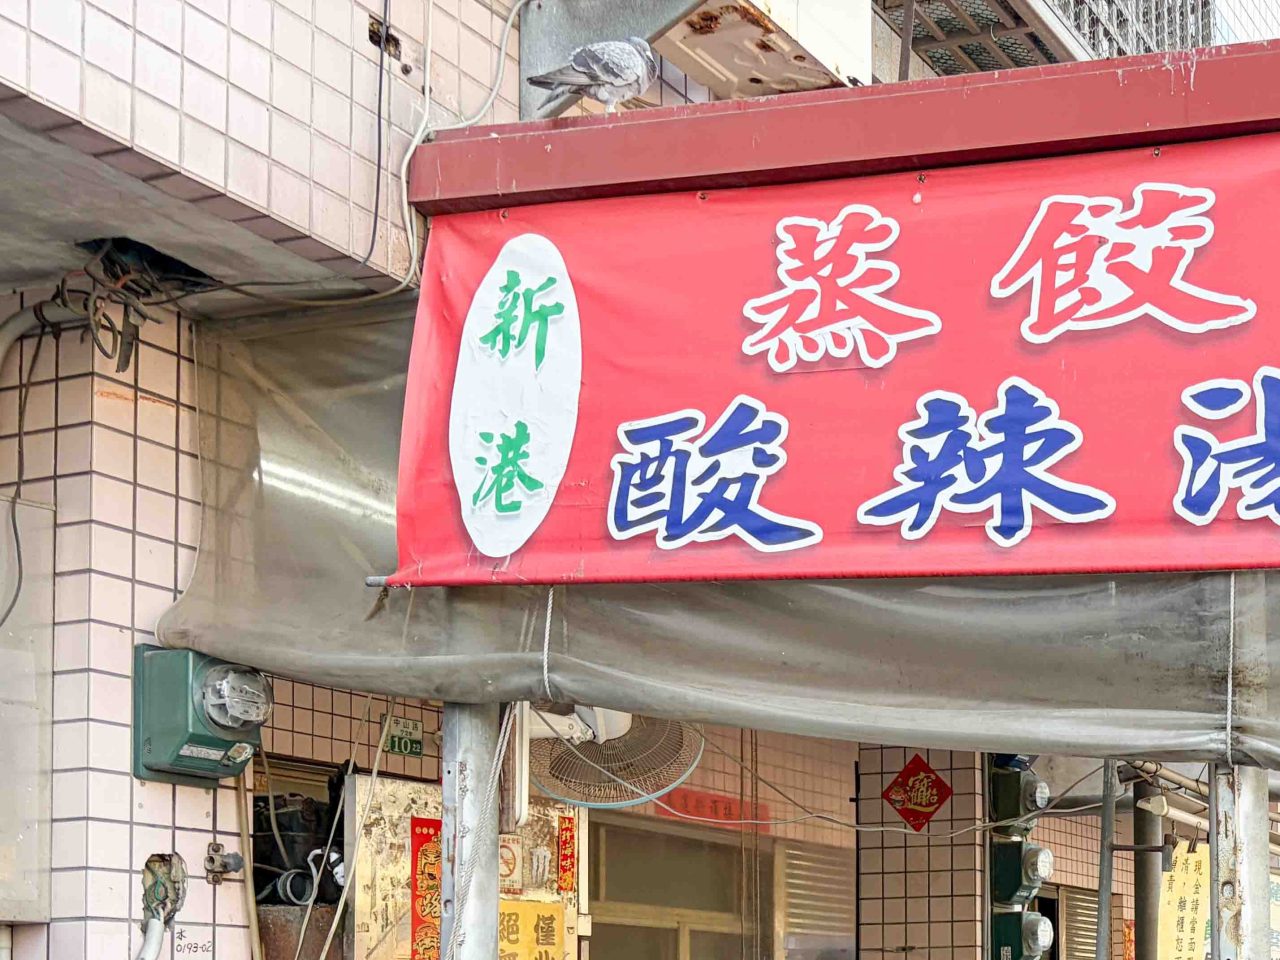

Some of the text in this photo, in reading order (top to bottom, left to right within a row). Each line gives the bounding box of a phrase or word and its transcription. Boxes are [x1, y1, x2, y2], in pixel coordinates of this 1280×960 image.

[742, 182, 1257, 373] 蒸餃
[472, 269, 564, 514] 新港
[175, 941, 213, 954] 0193-02
[176, 928, 187, 940] 水
